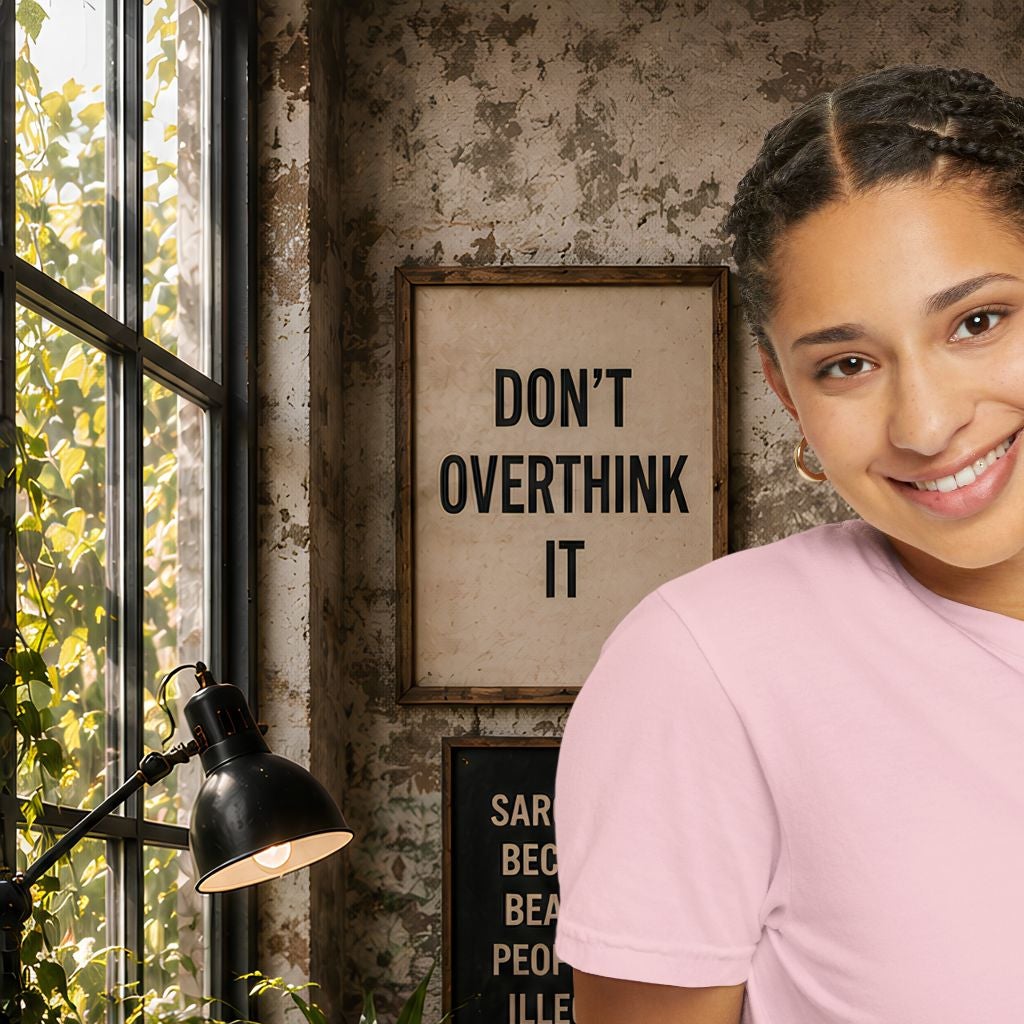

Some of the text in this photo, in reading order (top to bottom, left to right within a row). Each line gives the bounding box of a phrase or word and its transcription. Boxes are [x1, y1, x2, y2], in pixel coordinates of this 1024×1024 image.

[495, 368, 632, 428] DON'T
[439, 454, 690, 515] OVERTHINK
[545, 540, 585, 598] IT
